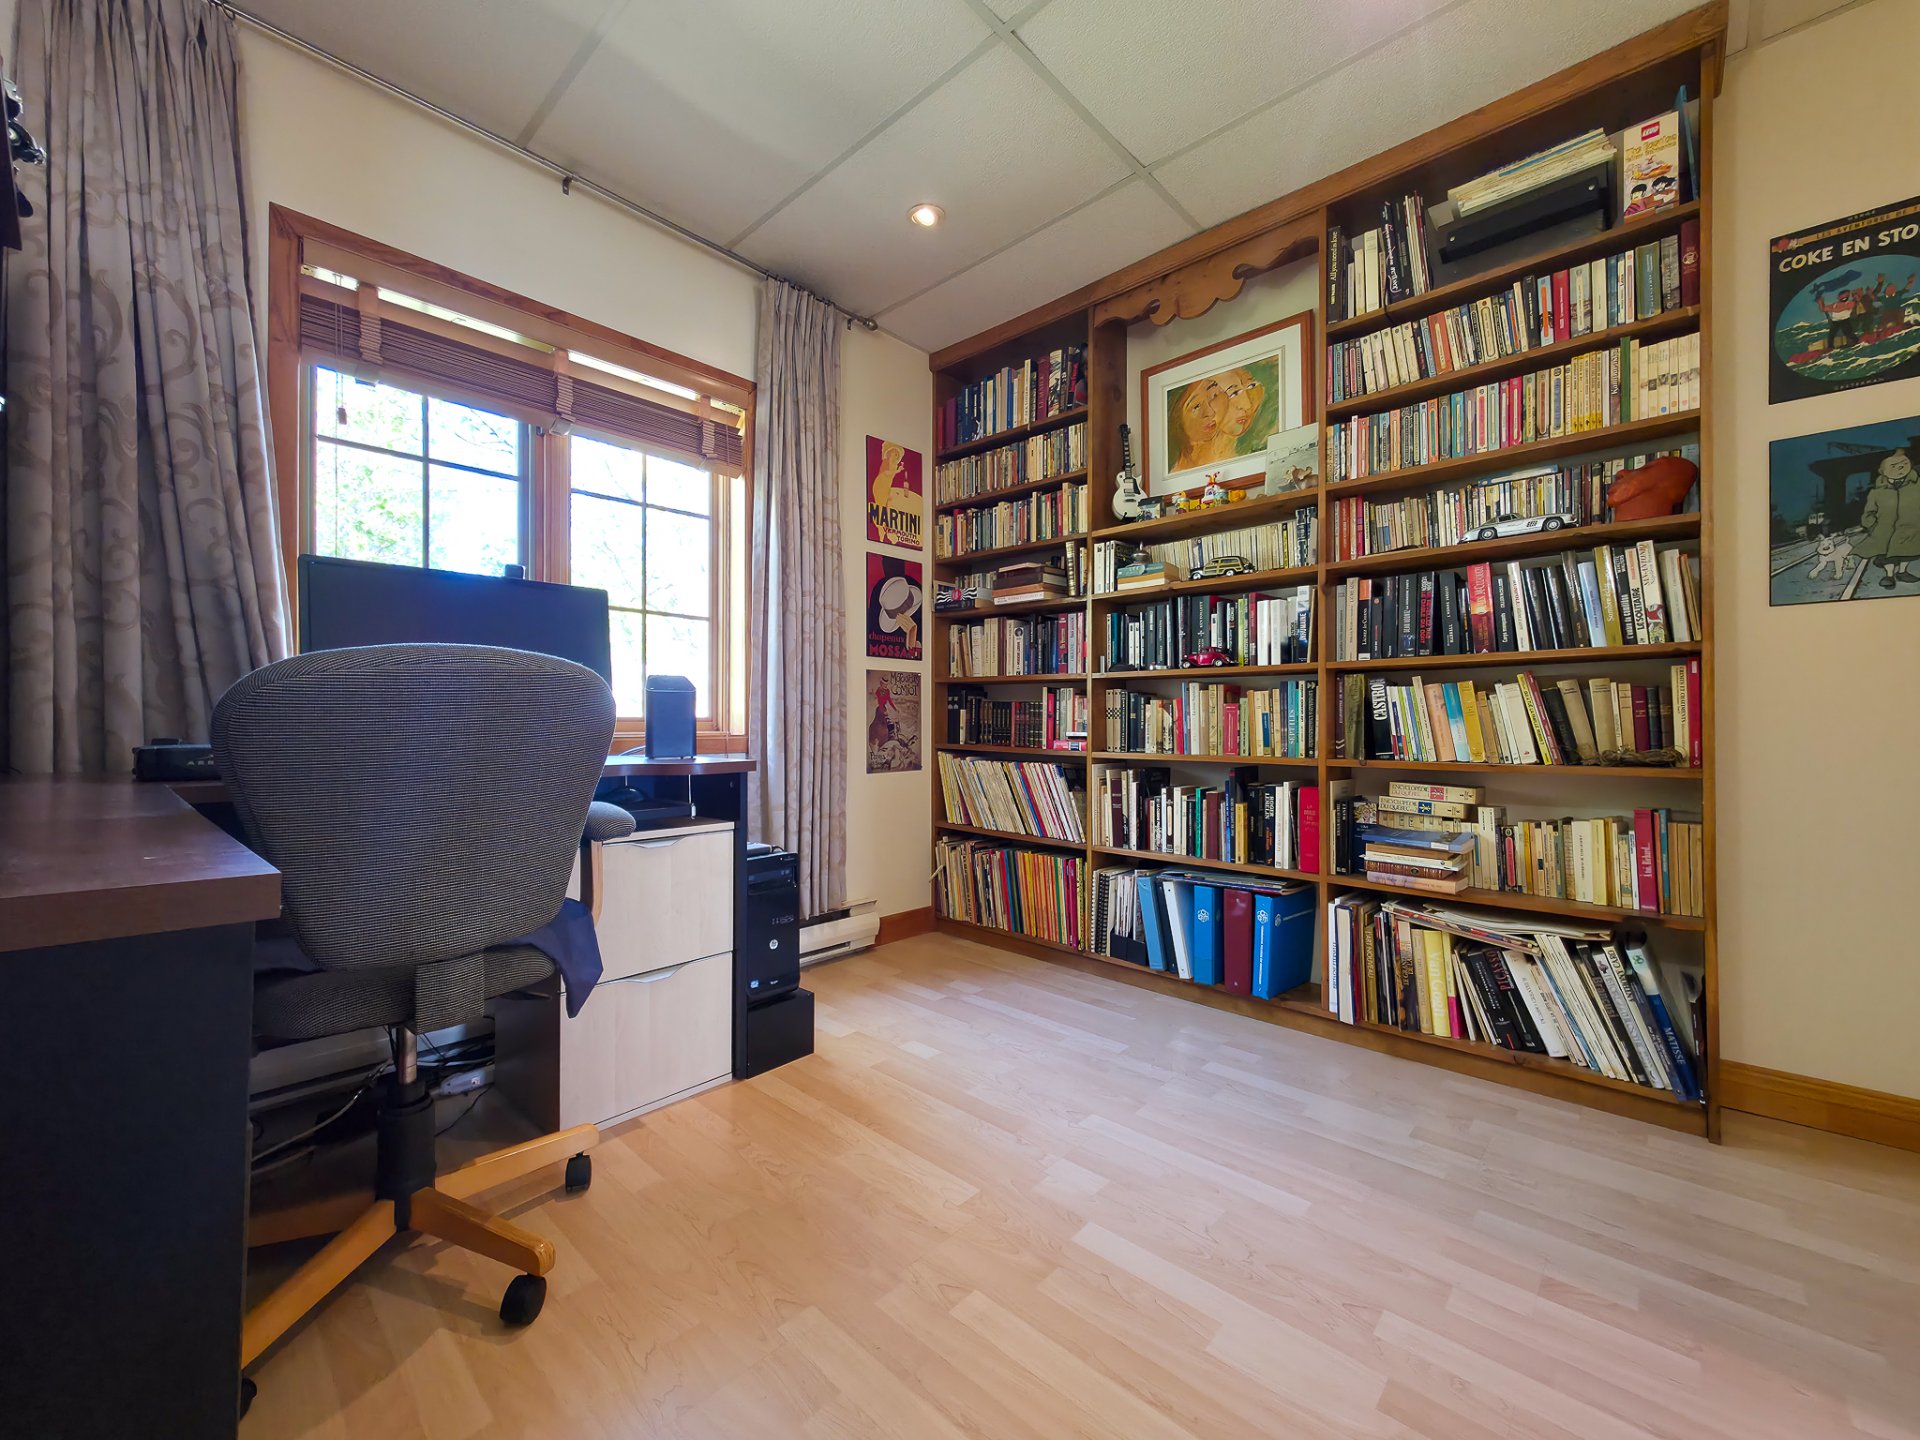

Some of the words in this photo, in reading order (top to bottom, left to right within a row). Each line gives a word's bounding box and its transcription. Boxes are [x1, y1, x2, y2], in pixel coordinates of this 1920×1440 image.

[1643, 126, 1659, 136] LEGO
[1330, 231, 1338, 242] love
[1778, 246, 1834, 273] COKE
[1842, 236, 1870, 257] EN
[1878, 223, 1920, 247] STO
[1330, 262, 1338, 274] you
[869, 502, 921, 536] MARTINI
[1631, 587, 1643, 622] SOLITAIRE
[1635, 622, 1645, 631] LE
[1370, 684, 1388, 721] CASTRO
[1366, 946, 1375, 979] NOUVEAU
[1429, 951, 1443, 977] Van
[1487, 951, 1512, 991] PICASSO
[1606, 949, 1621, 968] CARO
[1431, 979, 1446, 1017] Gogh
[1592, 976, 1619, 1019] Brancusi
[1616, 969, 1634, 1003] ANTHONY
[1663, 1026, 1687, 1065] MATISSE
